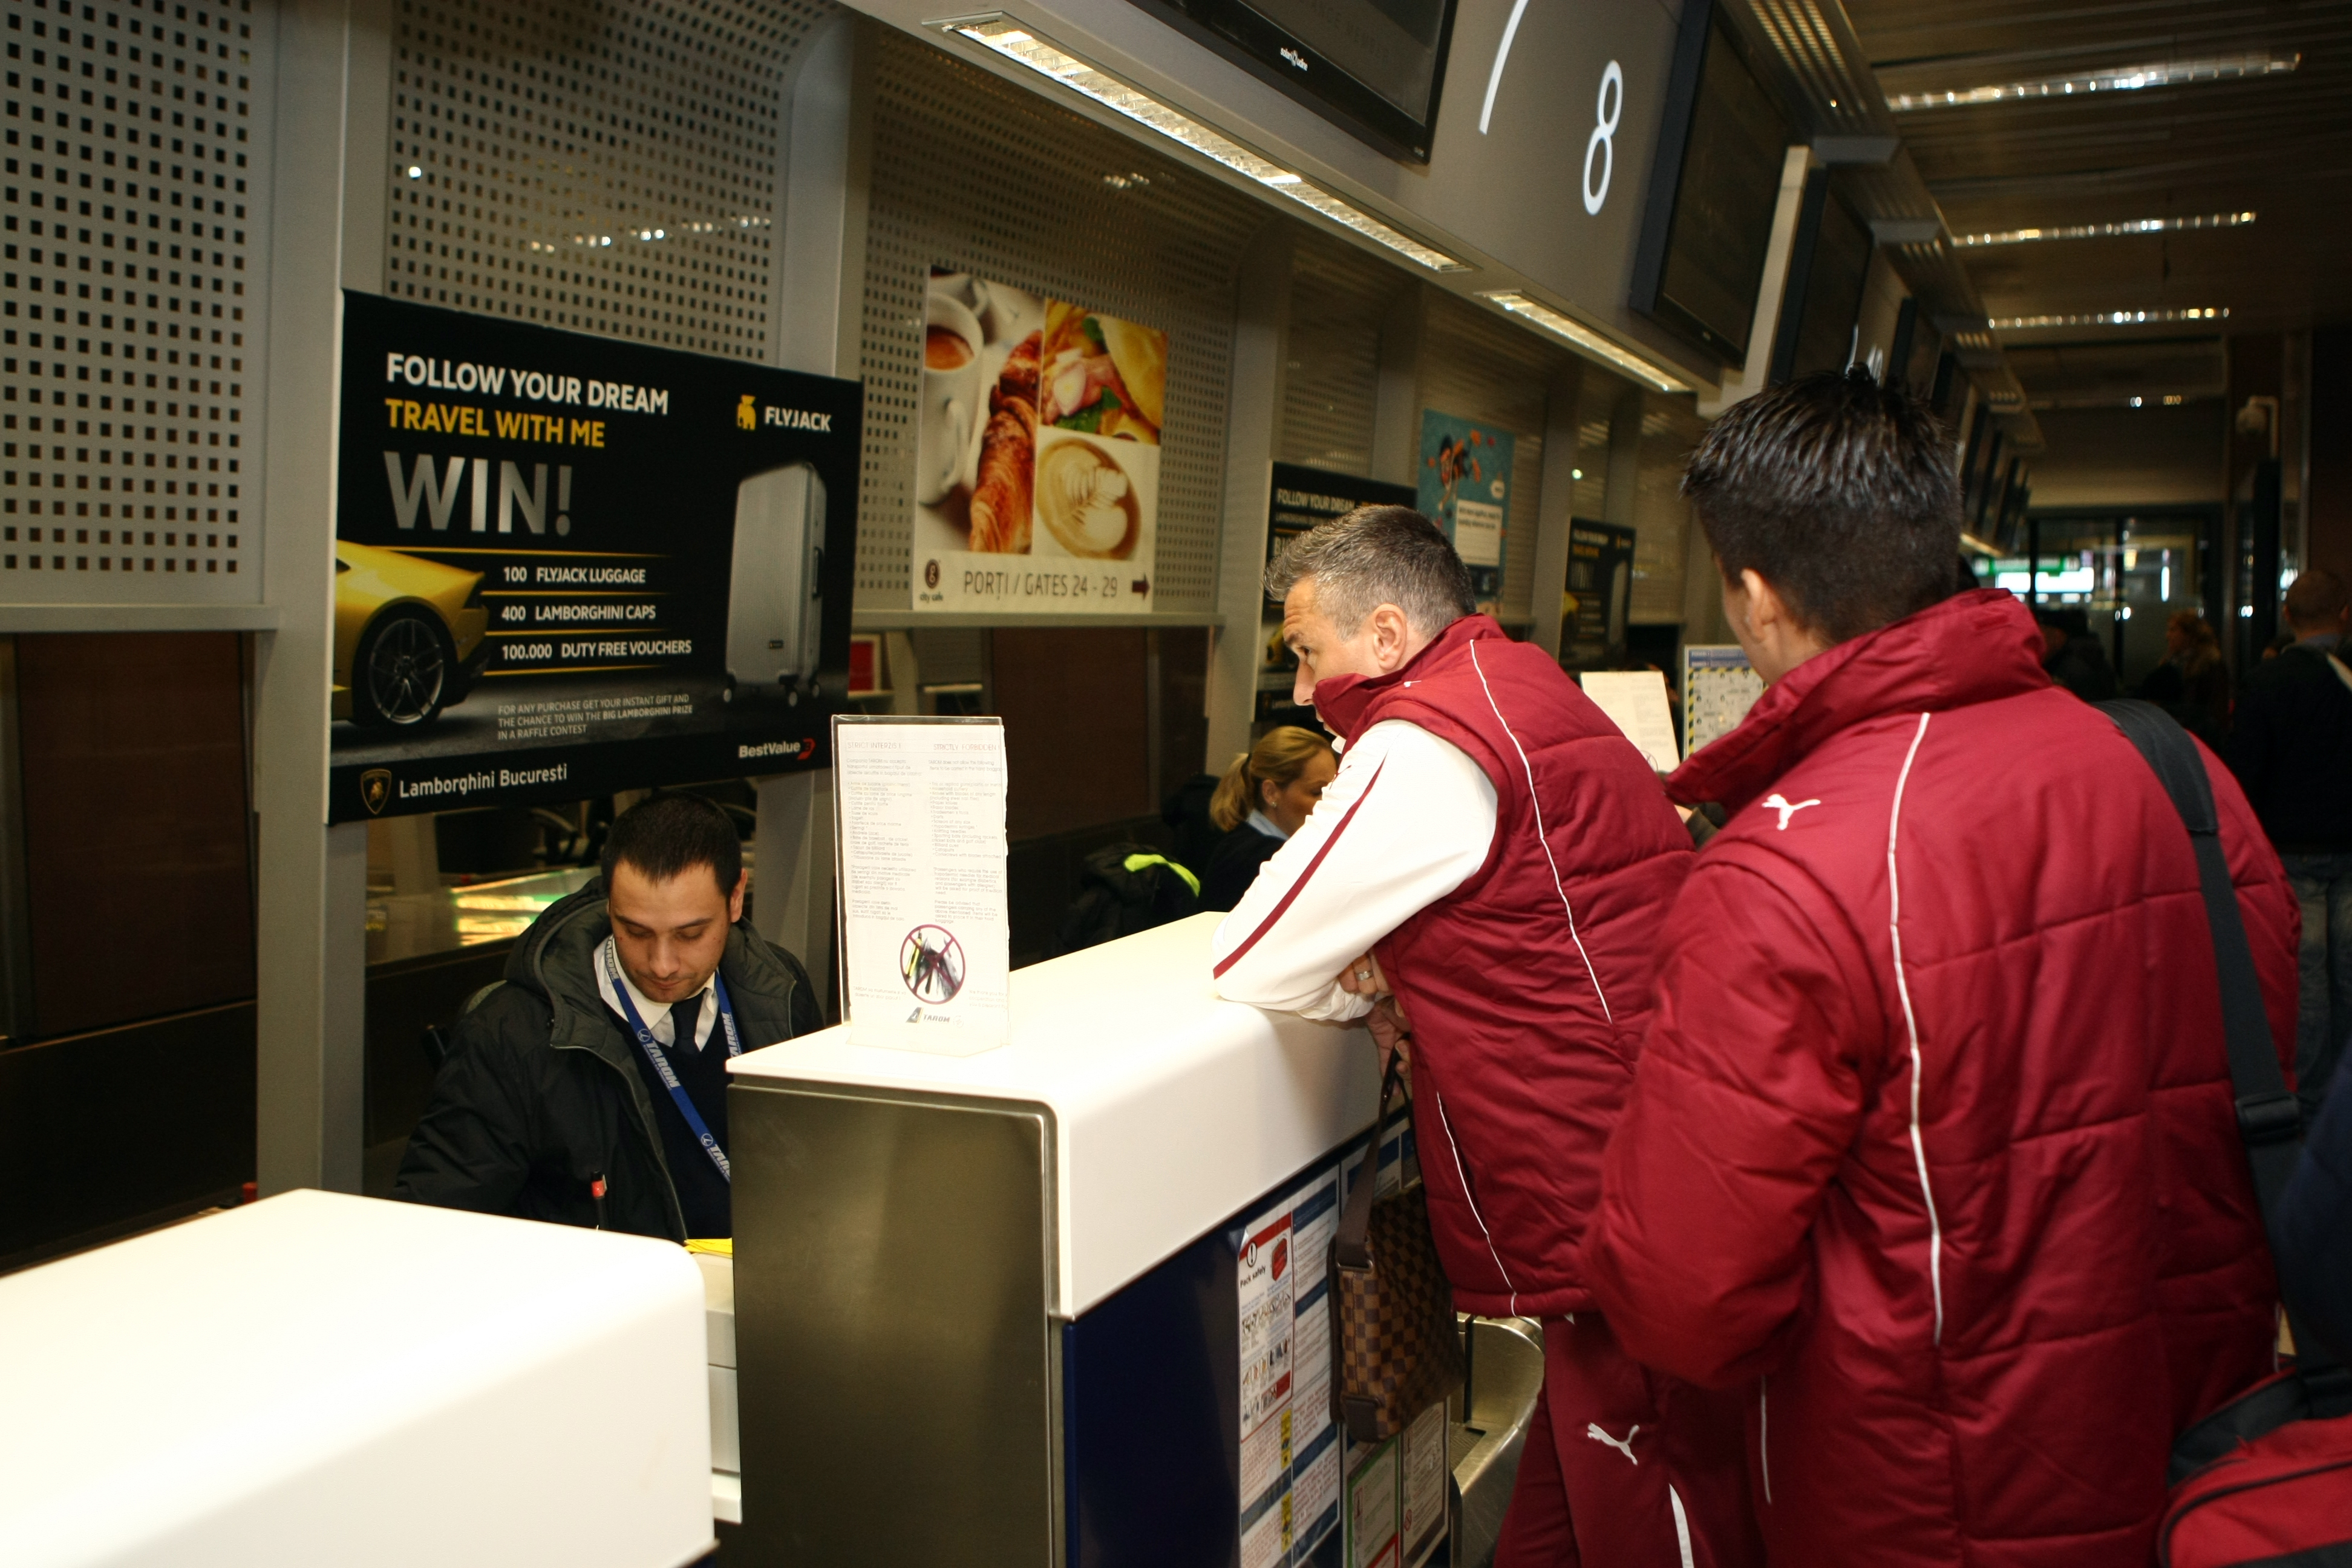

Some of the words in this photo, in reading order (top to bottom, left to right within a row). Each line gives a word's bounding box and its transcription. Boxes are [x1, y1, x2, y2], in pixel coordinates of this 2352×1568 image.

[1583, 59, 1623, 216] 8
[386, 352, 505, 397] FOLLOW
[510, 369, 581, 405] YOUR
[587, 379, 669, 416] DREAM
[385, 397, 490, 437] TRAVEL
[494, 409, 564, 445] WITH
[570, 419, 606, 448] ME
[765, 405, 832, 432] FLYJACK
[383, 450, 573, 537] WIN!
[503, 566, 527, 583] 100
[536, 567, 587, 583] FLYJACK
[589, 567, 646, 584] LUGGAGE
[1025, 573, 1067, 596] GATES
[1073, 575, 1088, 596] 24
[1102, 577, 1117, 597] 29
[501, 605, 526, 621] 400
[535, 605, 624, 621] LAMBORGHINI
[625, 605, 656, 619] CAPS
[501, 643, 552, 661] 100.000
[561, 641, 596, 658] DUTY
[598, 641, 627, 656] FREE
[629, 639, 692, 655] VOUCHERS
[498, 705, 515, 715] FOR
[517, 703, 535, 713] ANY
[537, 701, 581, 712] PURCHASE
[583, 699, 598, 709] GET
[599, 698, 621, 708] YOUR
[622, 696, 654, 707] INSTANT
[656, 694, 671, 704] GIFT
[673, 693, 690, 703] AND
[498, 717, 515, 728] THE
[517, 714, 552, 726] CHANCE
[554, 713, 565, 723] TO
[567, 712, 584, 722] WIN
[585, 711, 601, 720] THE
[603, 710, 616, 720] BIG
[618, 706, 671, 719] LAMBORGHINI
[672, 704, 693, 714] PRIZE
[498, 730, 508, 740] IN
[509, 730, 516, 739] A
[517, 727, 548, 739] RAFFLE
[550, 724, 587, 736] CONTEST
[739, 740, 801, 759] BestValue
[399, 770, 495, 798] Lamborghini
[500, 763, 567, 787] Bucuresti
[923, 1014, 950, 1023] TAROM
[646, 1040, 681, 1088] TAROM
[1240, 1275, 1252, 1289] Pack
